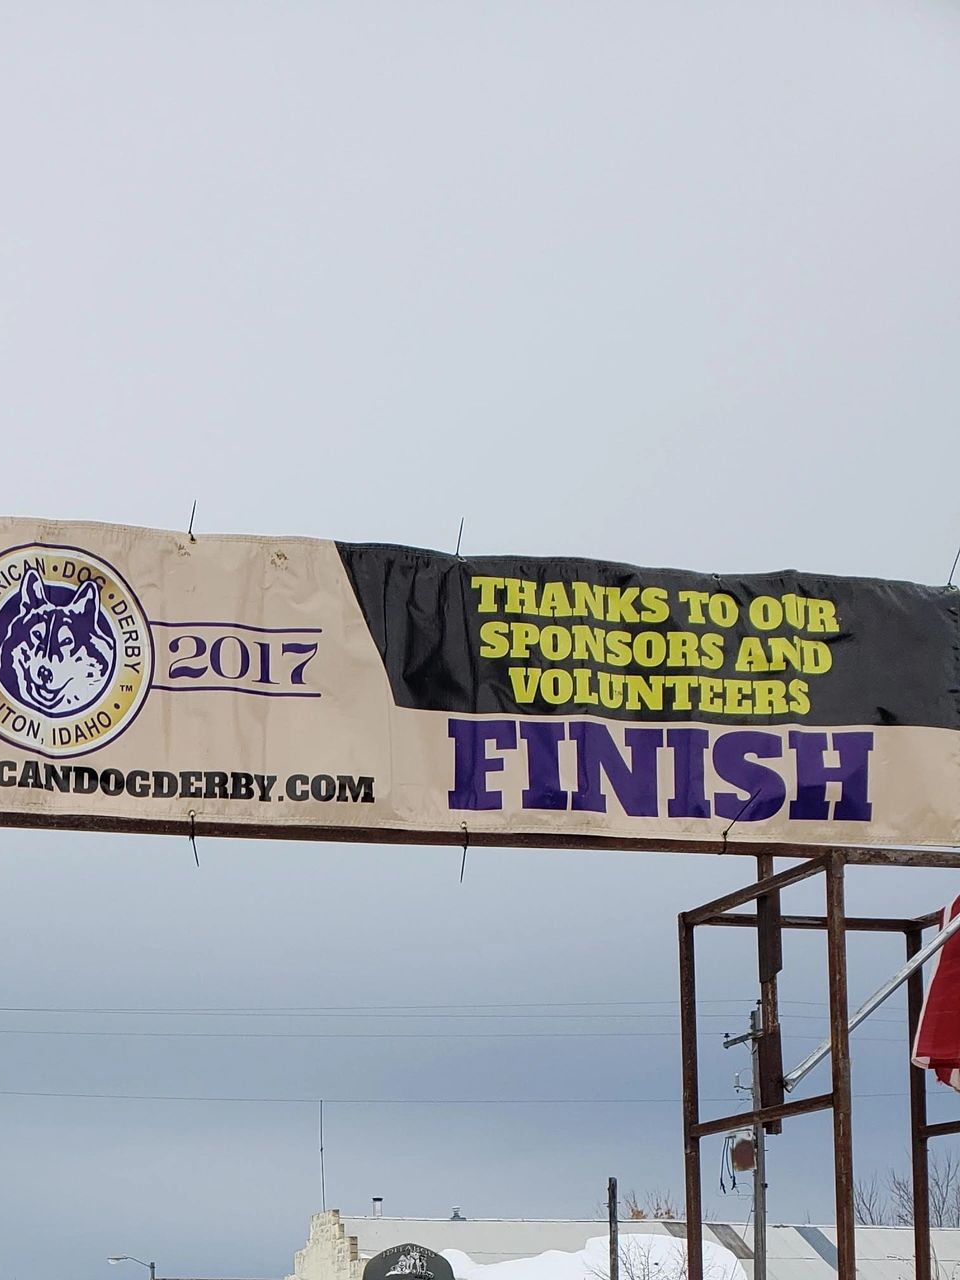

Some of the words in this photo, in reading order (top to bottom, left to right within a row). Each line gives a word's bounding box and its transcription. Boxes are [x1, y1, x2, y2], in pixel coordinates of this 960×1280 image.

[62, 561, 107, 592] DOG
[111, 600, 142, 674] DERBY
[471, 576, 671, 624] THANKS
[679, 591, 739, 629] TO
[748, 593, 840, 633] OUR
[168, 634, 319, 685] 2017
[478, 621, 725, 670] SPONSORS
[735, 635, 833, 675] AND
[508, 666, 811, 716] VOLUNTEERS
[52, 711, 112, 745] IDAHO
[447, 718, 874, 822] FINISH
